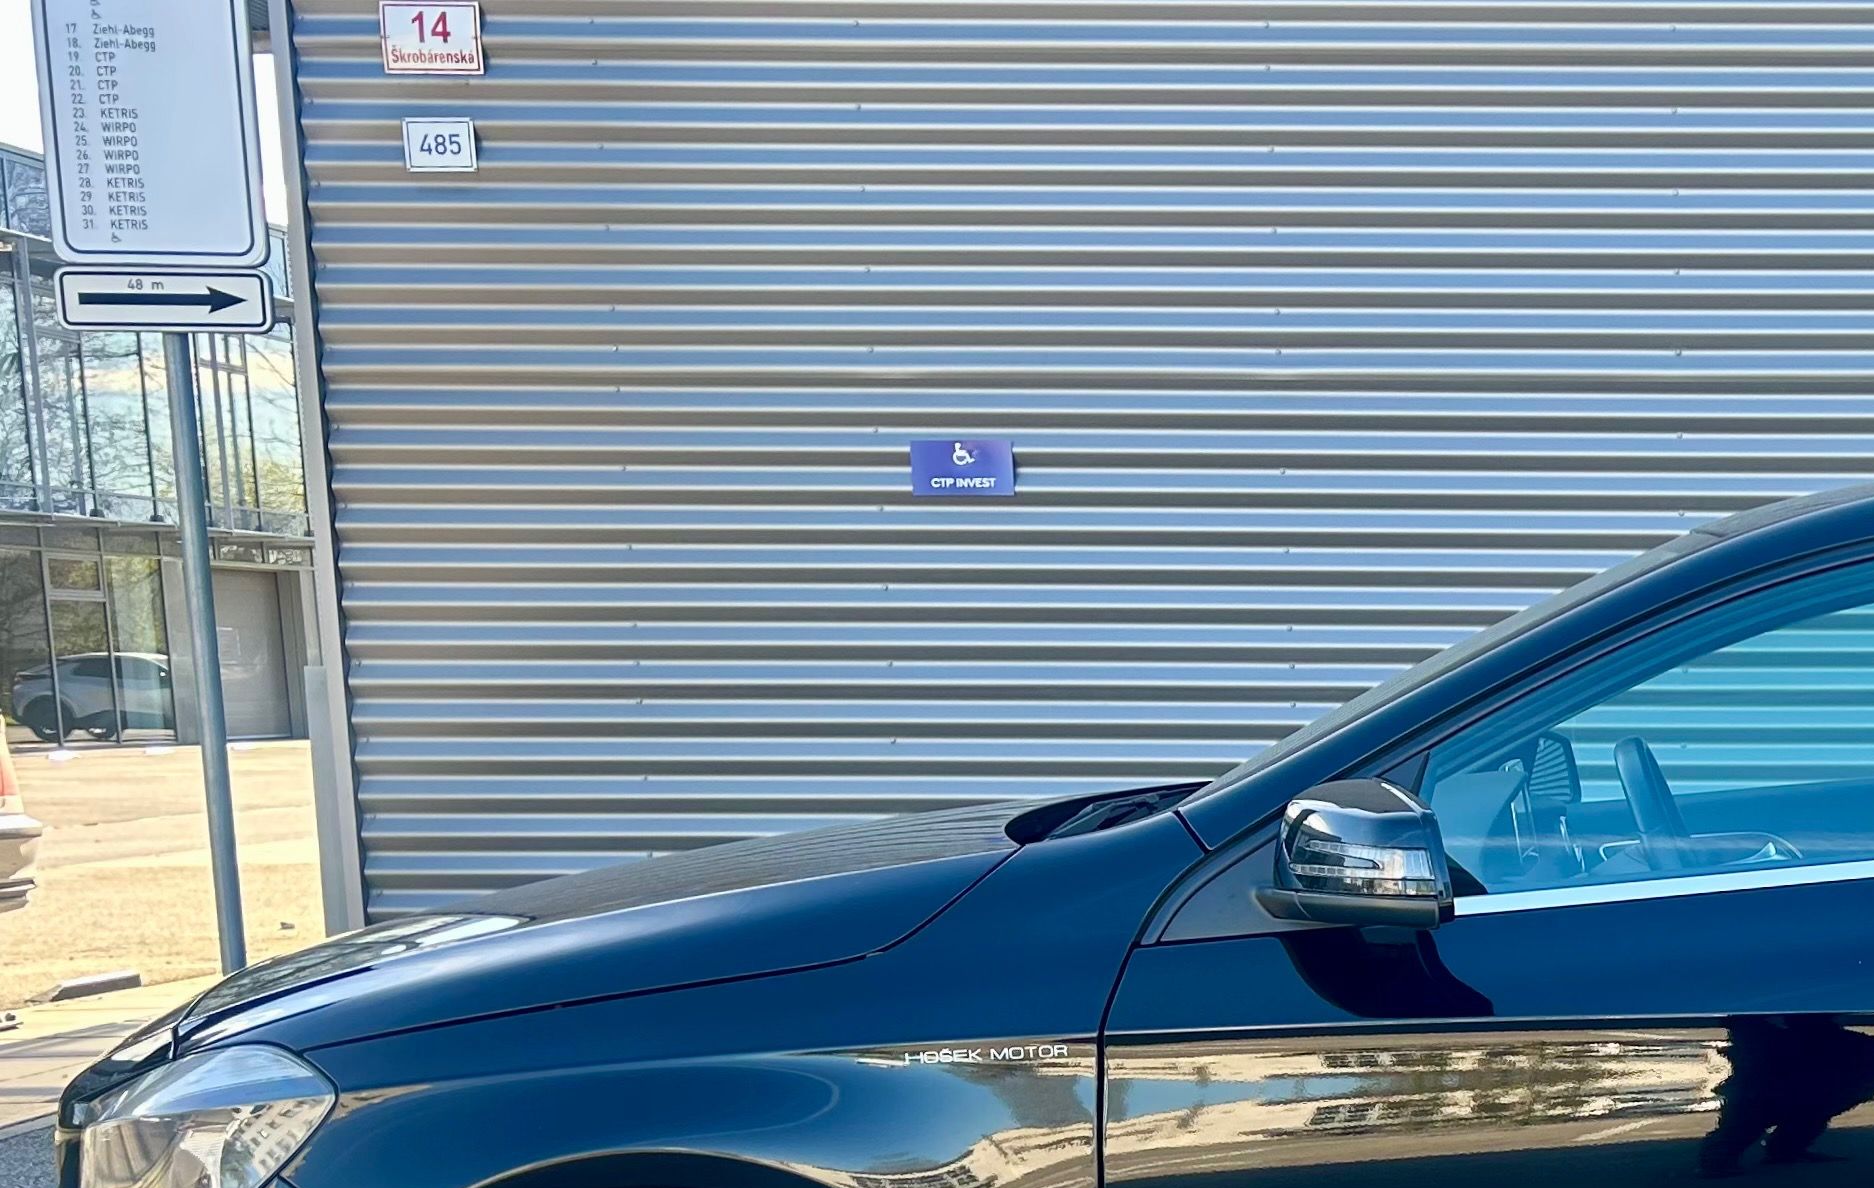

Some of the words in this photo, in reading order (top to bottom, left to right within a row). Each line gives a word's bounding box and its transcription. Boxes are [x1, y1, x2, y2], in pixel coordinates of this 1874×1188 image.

[93, 23, 155, 38] Ziehl-Abegg
[411, 11, 451, 43] 14
[94, 37, 156, 52] Ziehl-Abegg
[95, 52, 116, 62] CTP
[391, 44, 475, 64] Škrobárenská
[96, 66, 117, 76] CTP
[97, 79, 118, 90] CTP
[99, 93, 119, 104] CTP
[100, 107, 138, 119] KETRIS
[101, 122, 137, 133] WIRPO
[102, 136, 138, 147] WIRPO
[420, 134, 462, 155] 485
[103, 150, 139, 161] WIRPO
[105, 164, 140, 175] WIRPO
[107, 178, 145, 189] KETRIS
[108, 191, 146, 202] KETRIS
[109, 205, 147, 216] KETRIS
[111, 219, 148, 230] KETRIS
[127, 279, 143, 290] 48
[151, 281, 164, 290] m
[930, 477, 955, 488] CTP
[956, 478, 996, 488] INVEST
[990, 1044, 1068, 1060] MOTOR
